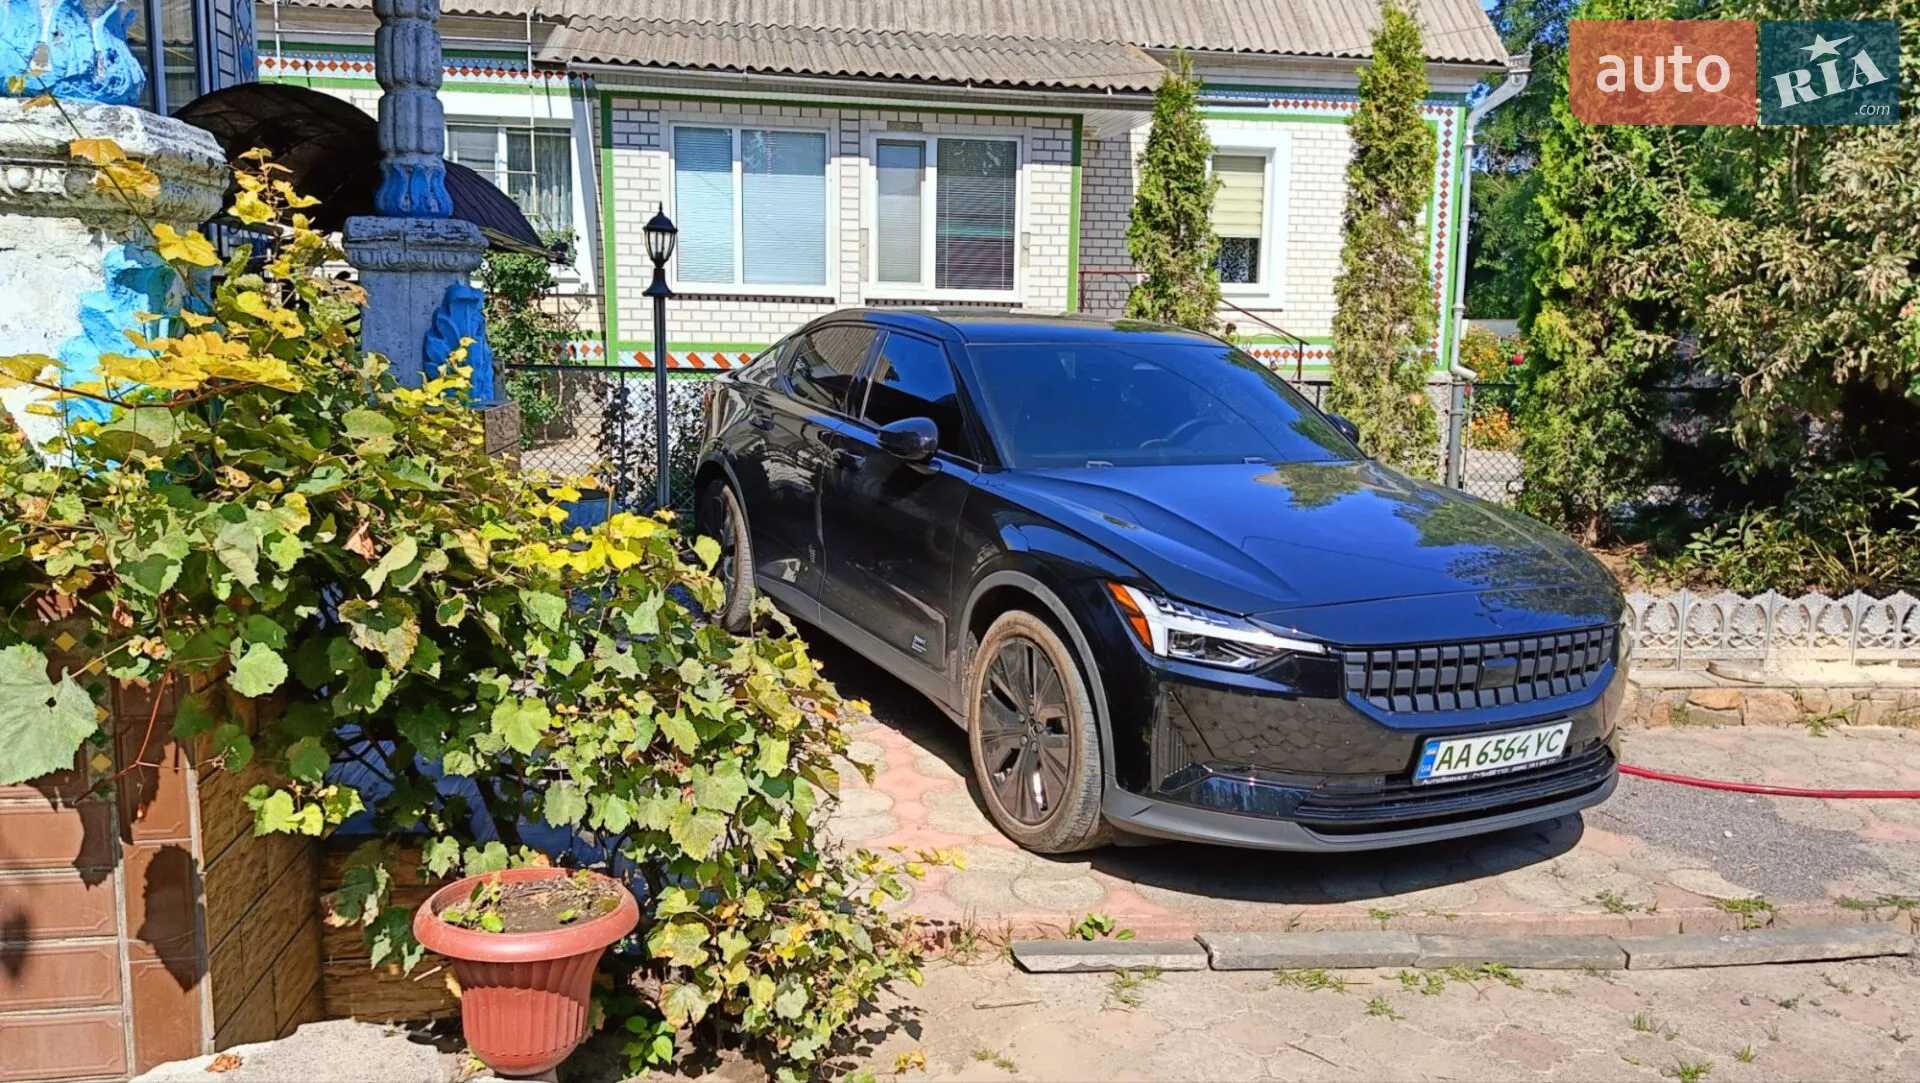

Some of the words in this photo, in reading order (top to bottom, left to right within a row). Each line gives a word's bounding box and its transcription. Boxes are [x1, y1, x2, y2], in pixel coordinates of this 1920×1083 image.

[1435, 743, 1472, 772] AA
[1476, 734, 1532, 766] 6564
[1535, 728, 1564, 757] YC
[1420, 764, 1432, 772] UA
